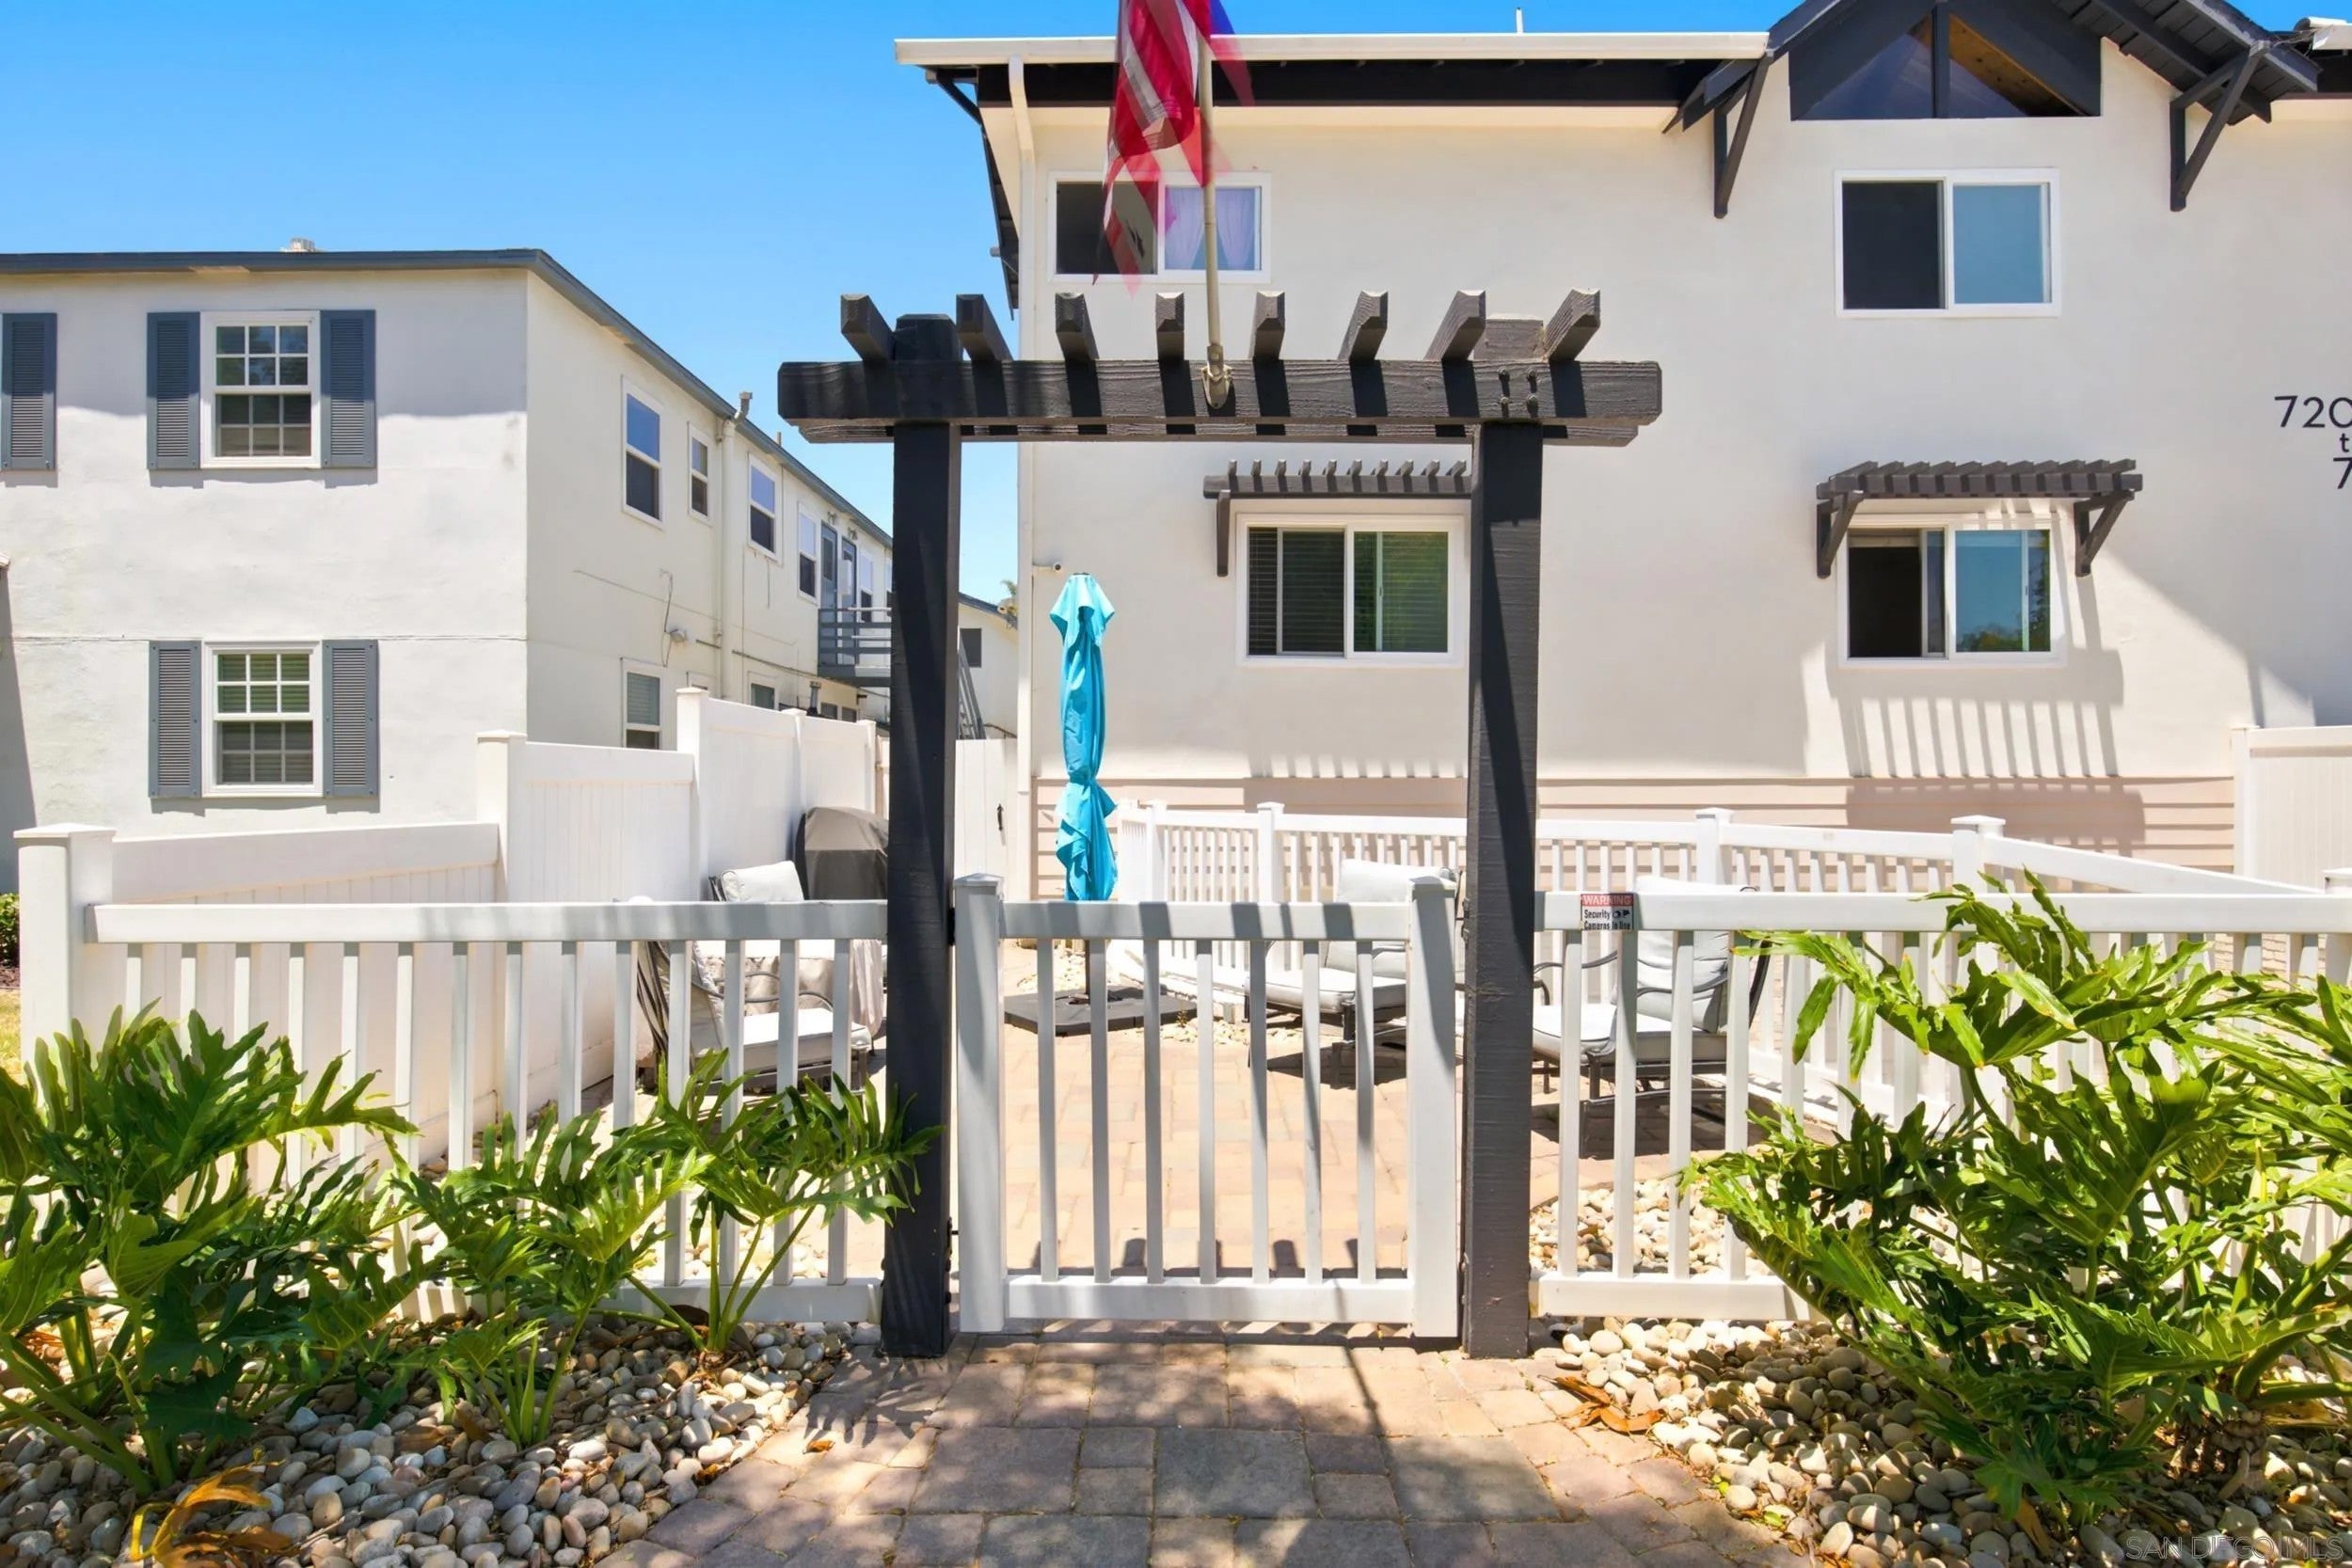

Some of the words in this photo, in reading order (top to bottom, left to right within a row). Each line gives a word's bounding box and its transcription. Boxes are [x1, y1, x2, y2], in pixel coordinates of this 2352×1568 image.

[1583, 895, 1631, 905] WARNING
[1584, 909, 1611, 919] Security
[1584, 920, 1611, 930] Cameras
[1619, 921, 1630, 930] Use
